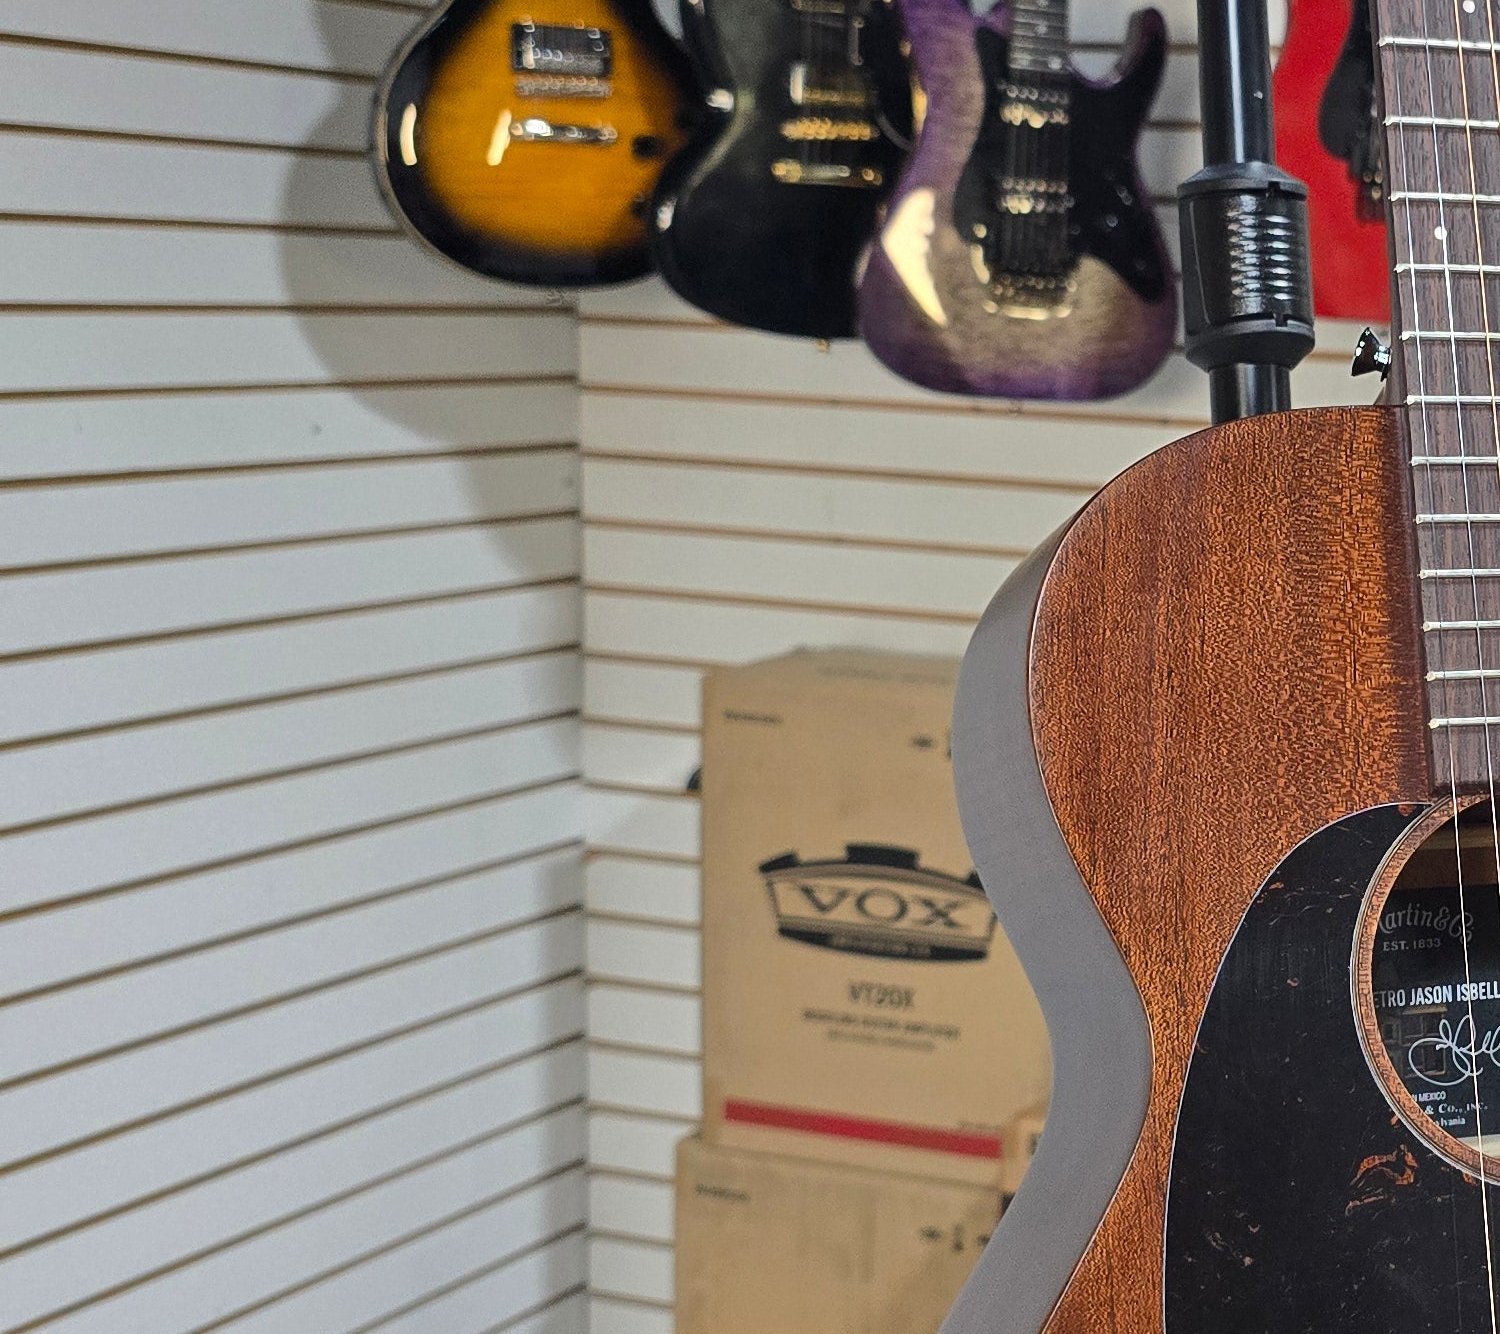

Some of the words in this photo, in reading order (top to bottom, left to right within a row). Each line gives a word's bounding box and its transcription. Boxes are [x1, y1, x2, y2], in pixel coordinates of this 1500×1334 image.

[797, 882, 967, 929] VOX
[1383, 940, 1409, 951] EST.
[1413, 938, 1441, 950] 1833
[1409, 984, 1453, 1006] JASON
[1418, 1091, 1446, 1102] MEXICO
